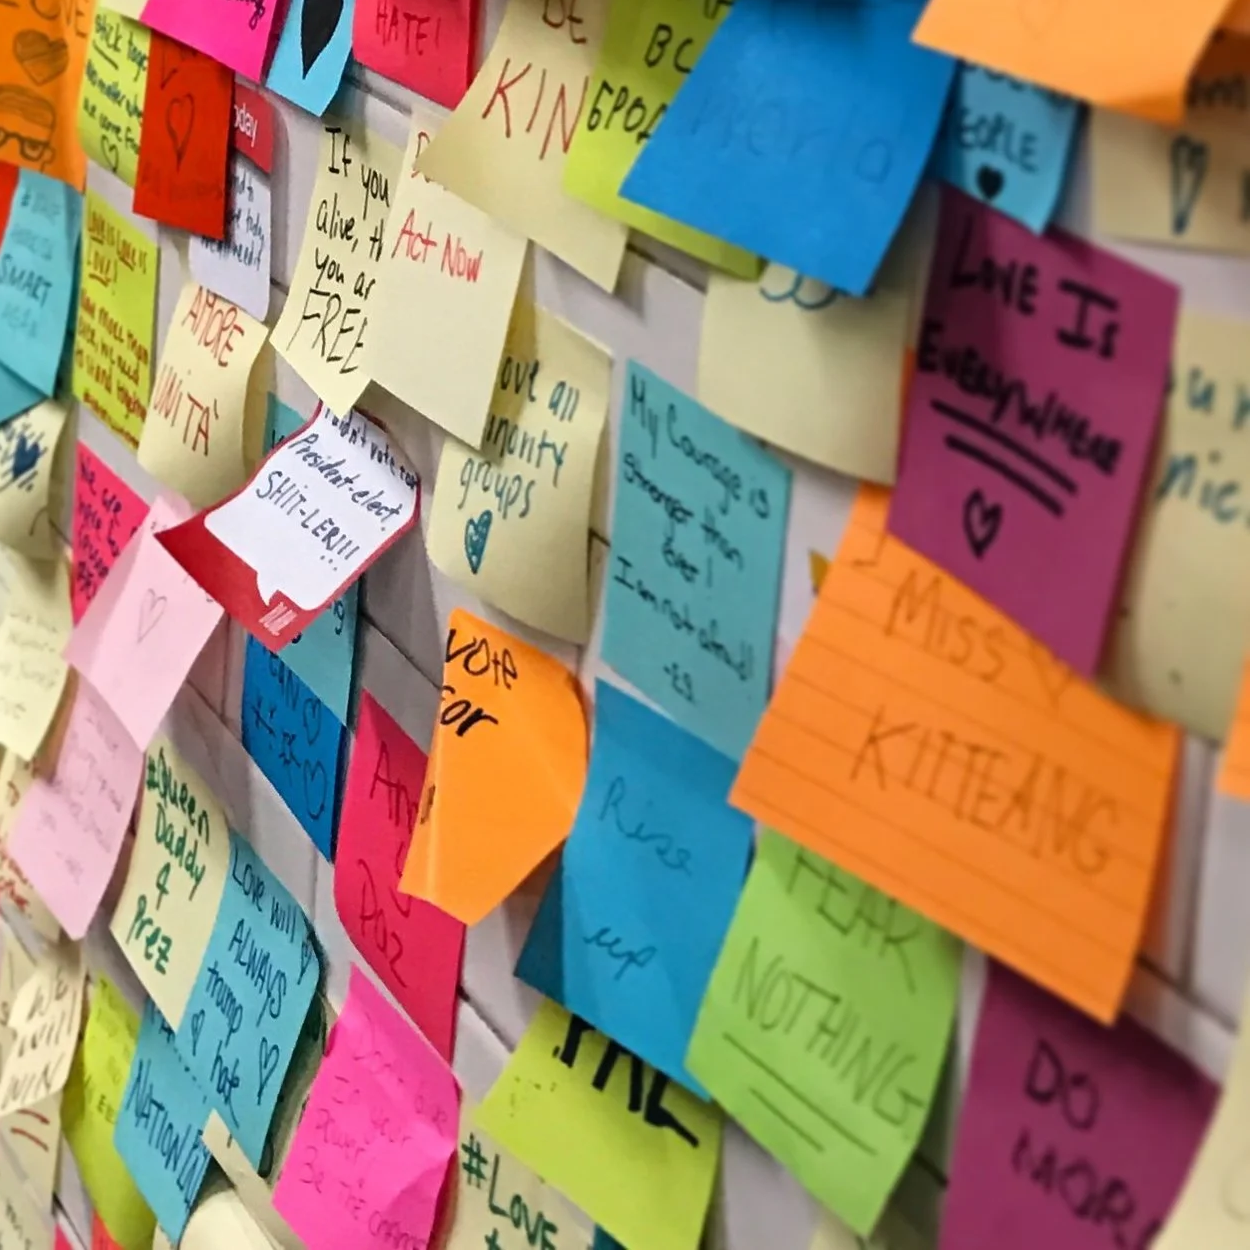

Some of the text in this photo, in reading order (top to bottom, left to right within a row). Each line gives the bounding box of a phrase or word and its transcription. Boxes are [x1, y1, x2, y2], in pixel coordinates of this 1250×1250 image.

[181, 284, 246, 368] AMORE
[457, 457, 536, 521] groups
[1024, 1039, 1100, 1130] DO
